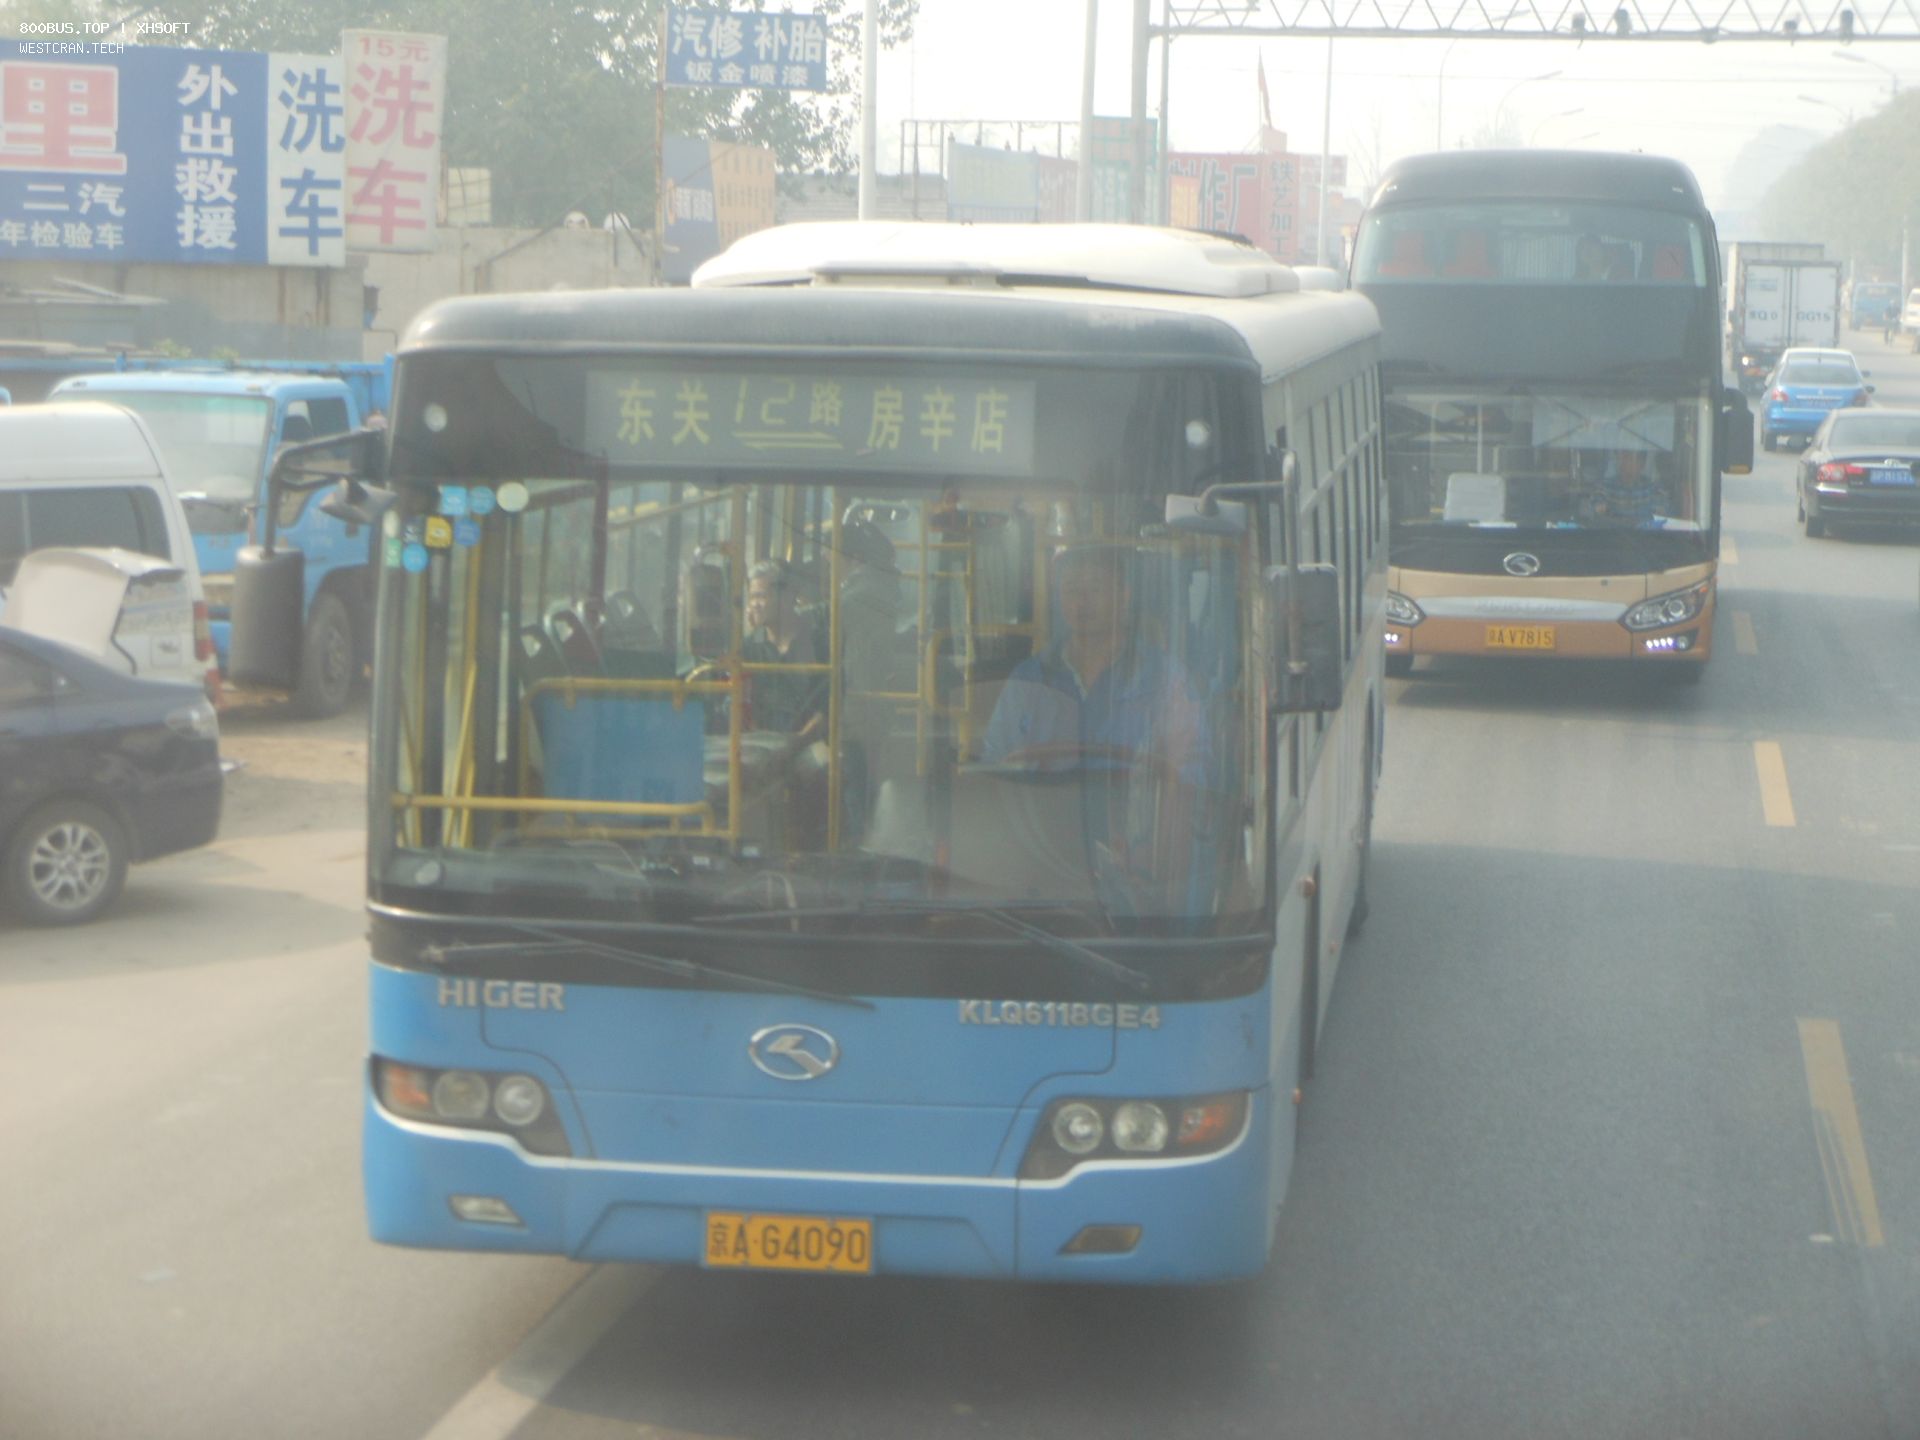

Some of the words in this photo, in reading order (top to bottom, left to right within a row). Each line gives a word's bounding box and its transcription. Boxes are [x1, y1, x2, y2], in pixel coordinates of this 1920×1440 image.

[358, 36, 431, 63] 15元
[174, 64, 238, 250] 外出救援
[278, 67, 345, 257] 洗车
[346, 62, 436, 246] 洗车
[1270, 159, 1296, 256] 铁艺加工
[437, 978, 565, 1011] HIGER
[957, 998, 1162, 1029] KLQ6118GE4
